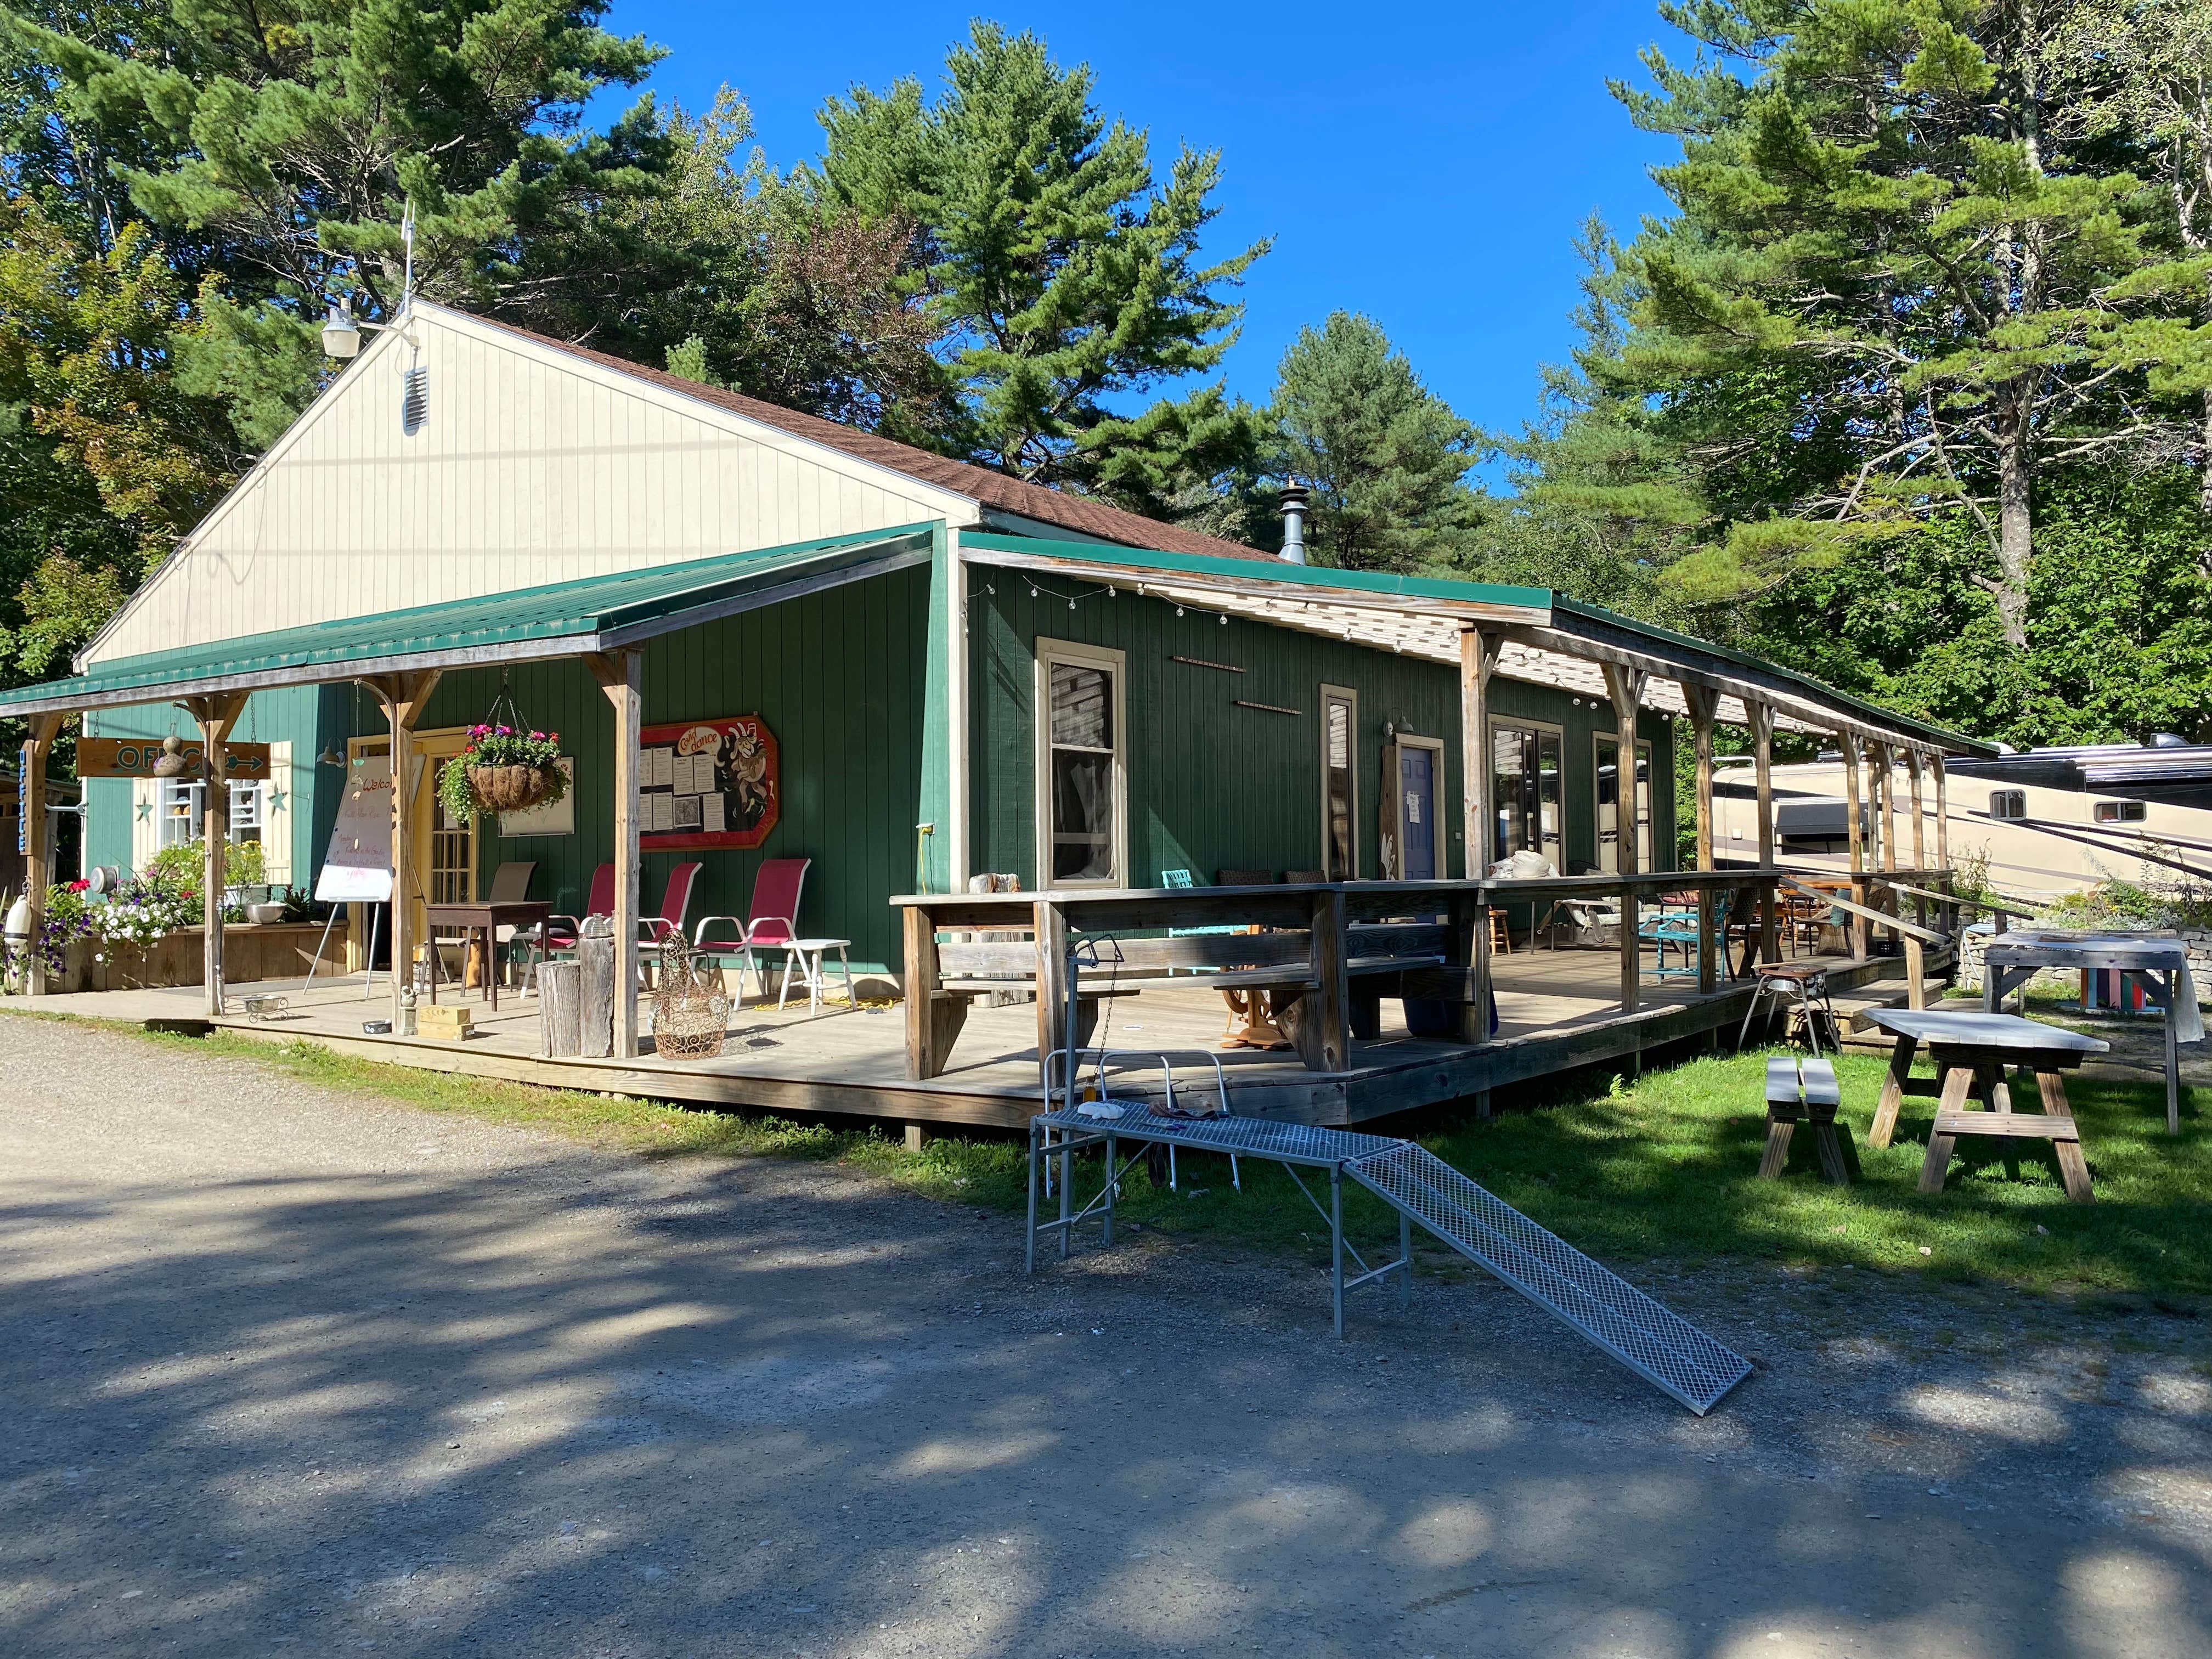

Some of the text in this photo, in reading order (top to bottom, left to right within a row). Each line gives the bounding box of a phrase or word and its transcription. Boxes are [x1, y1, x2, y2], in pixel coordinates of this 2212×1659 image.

[681, 726, 697, 750] Covid
[692, 733, 717, 752] dance
[363, 778, 392, 791] Welco
